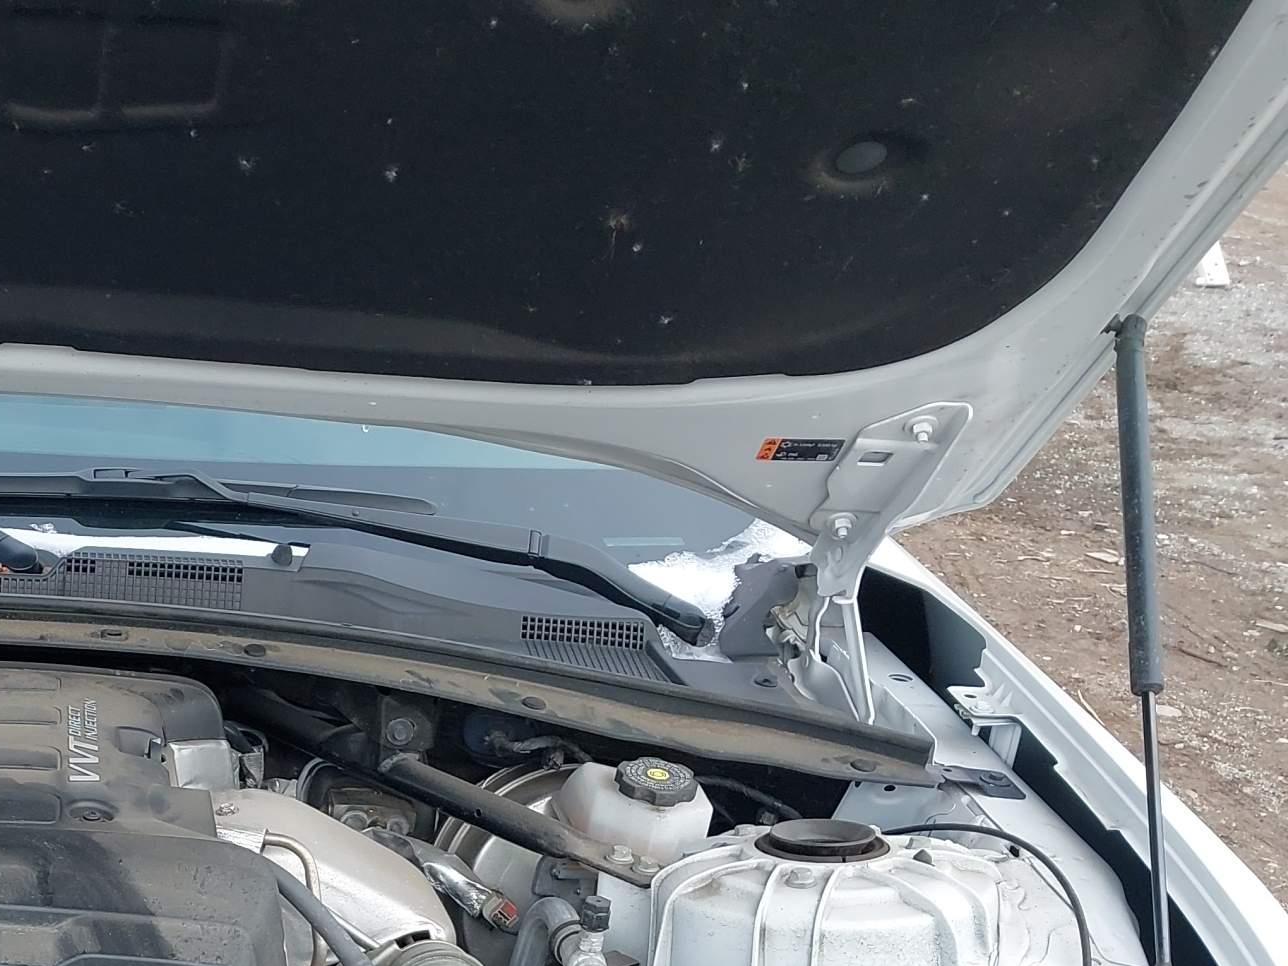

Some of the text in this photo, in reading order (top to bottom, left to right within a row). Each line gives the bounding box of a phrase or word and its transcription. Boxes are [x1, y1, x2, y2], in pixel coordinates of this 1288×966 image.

[68, 704, 81, 736] DIRECT
[84, 697, 98, 741] INJECTION
[68, 735, 100, 781] VVT
